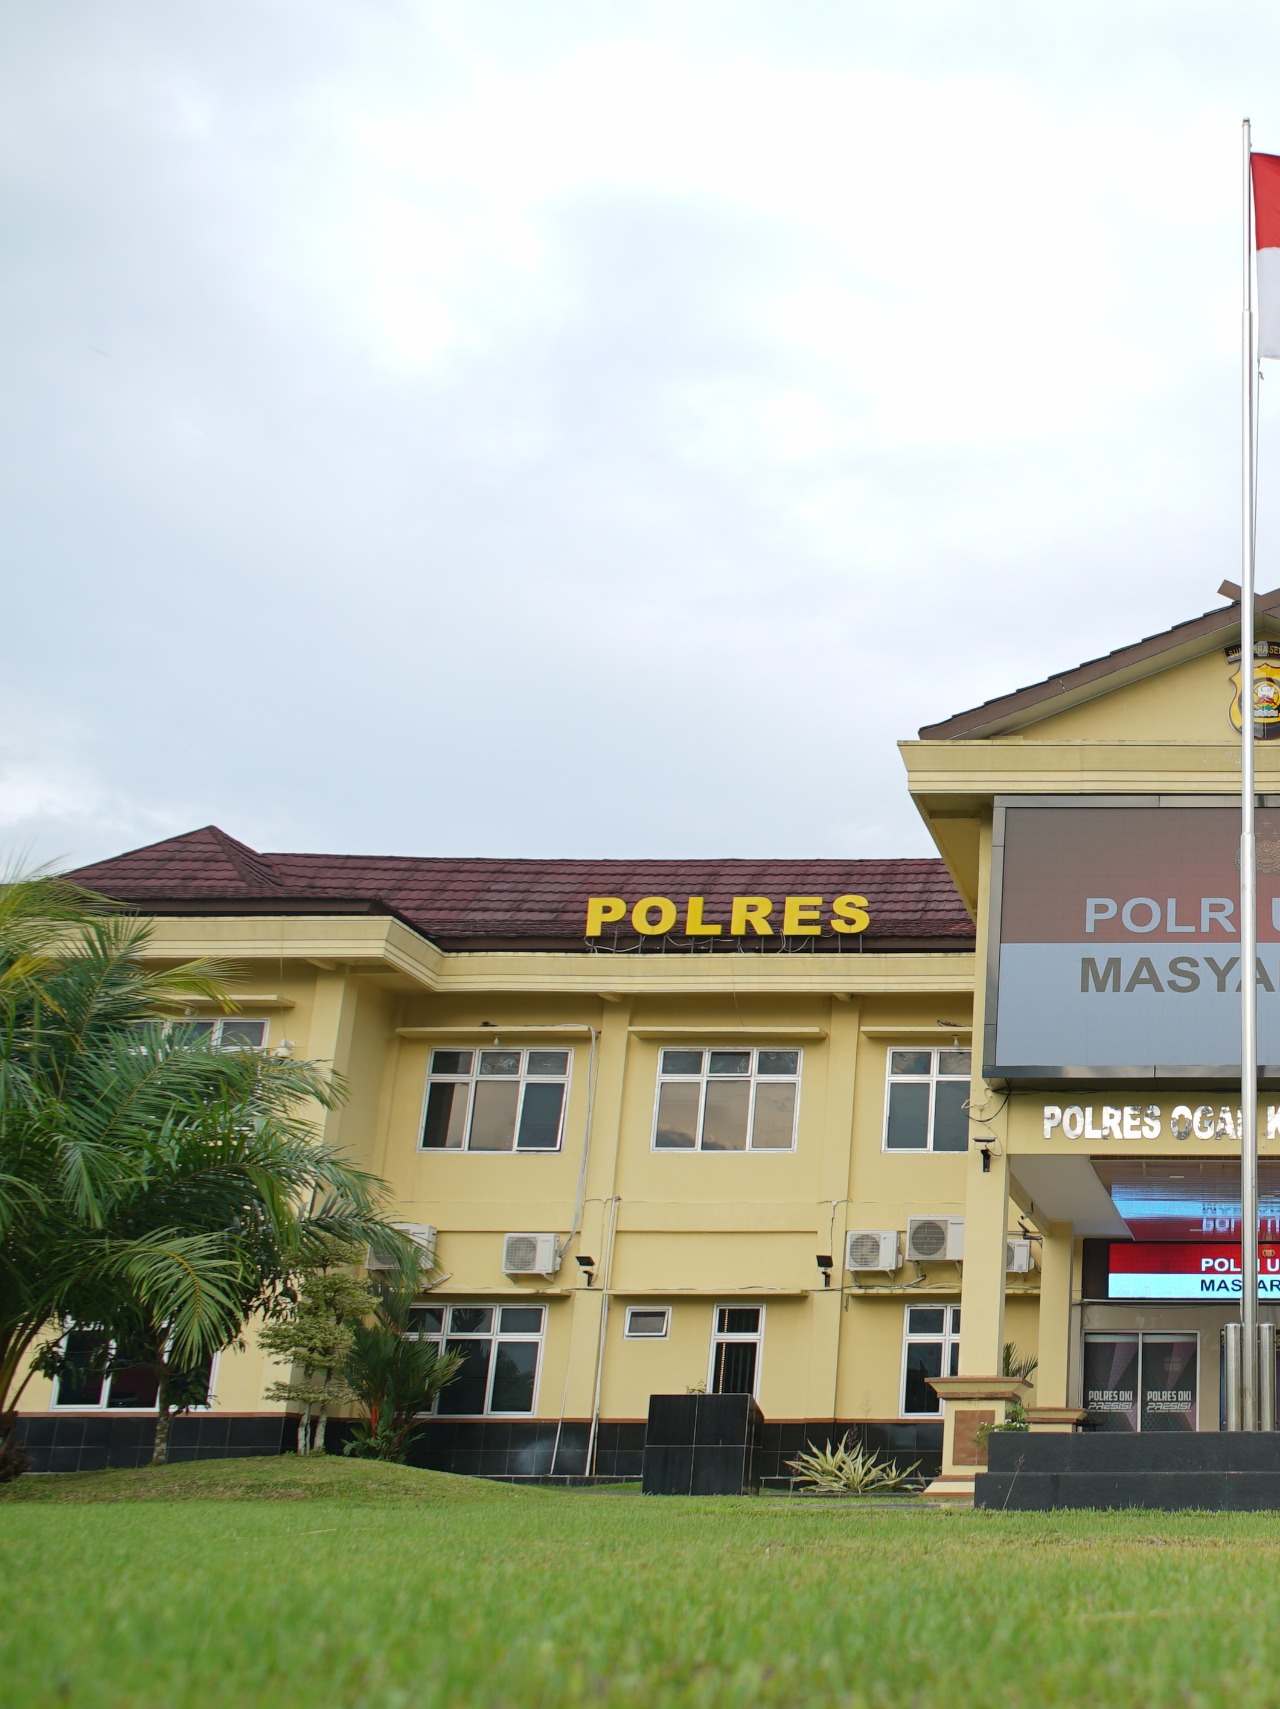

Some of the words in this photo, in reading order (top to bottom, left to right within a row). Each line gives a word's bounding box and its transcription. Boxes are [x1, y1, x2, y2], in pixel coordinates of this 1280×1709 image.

[585, 894, 870, 936] POLRES
[1085, 897, 1237, 933] POLR
[1043, 1105, 1161, 1139] POLRES
[1201, 1258, 1260, 1272] POLI
[1088, 1390, 1118, 1401] POLRES
[1119, 1390, 1133, 1401] OKI
[1147, 1390, 1176, 1401] POLRES
[1178, 1390, 1192, 1401] OKI
[1088, 1401, 1133, 1410] PRESISI
[1146, 1402, 1192, 1410] PRESISI
